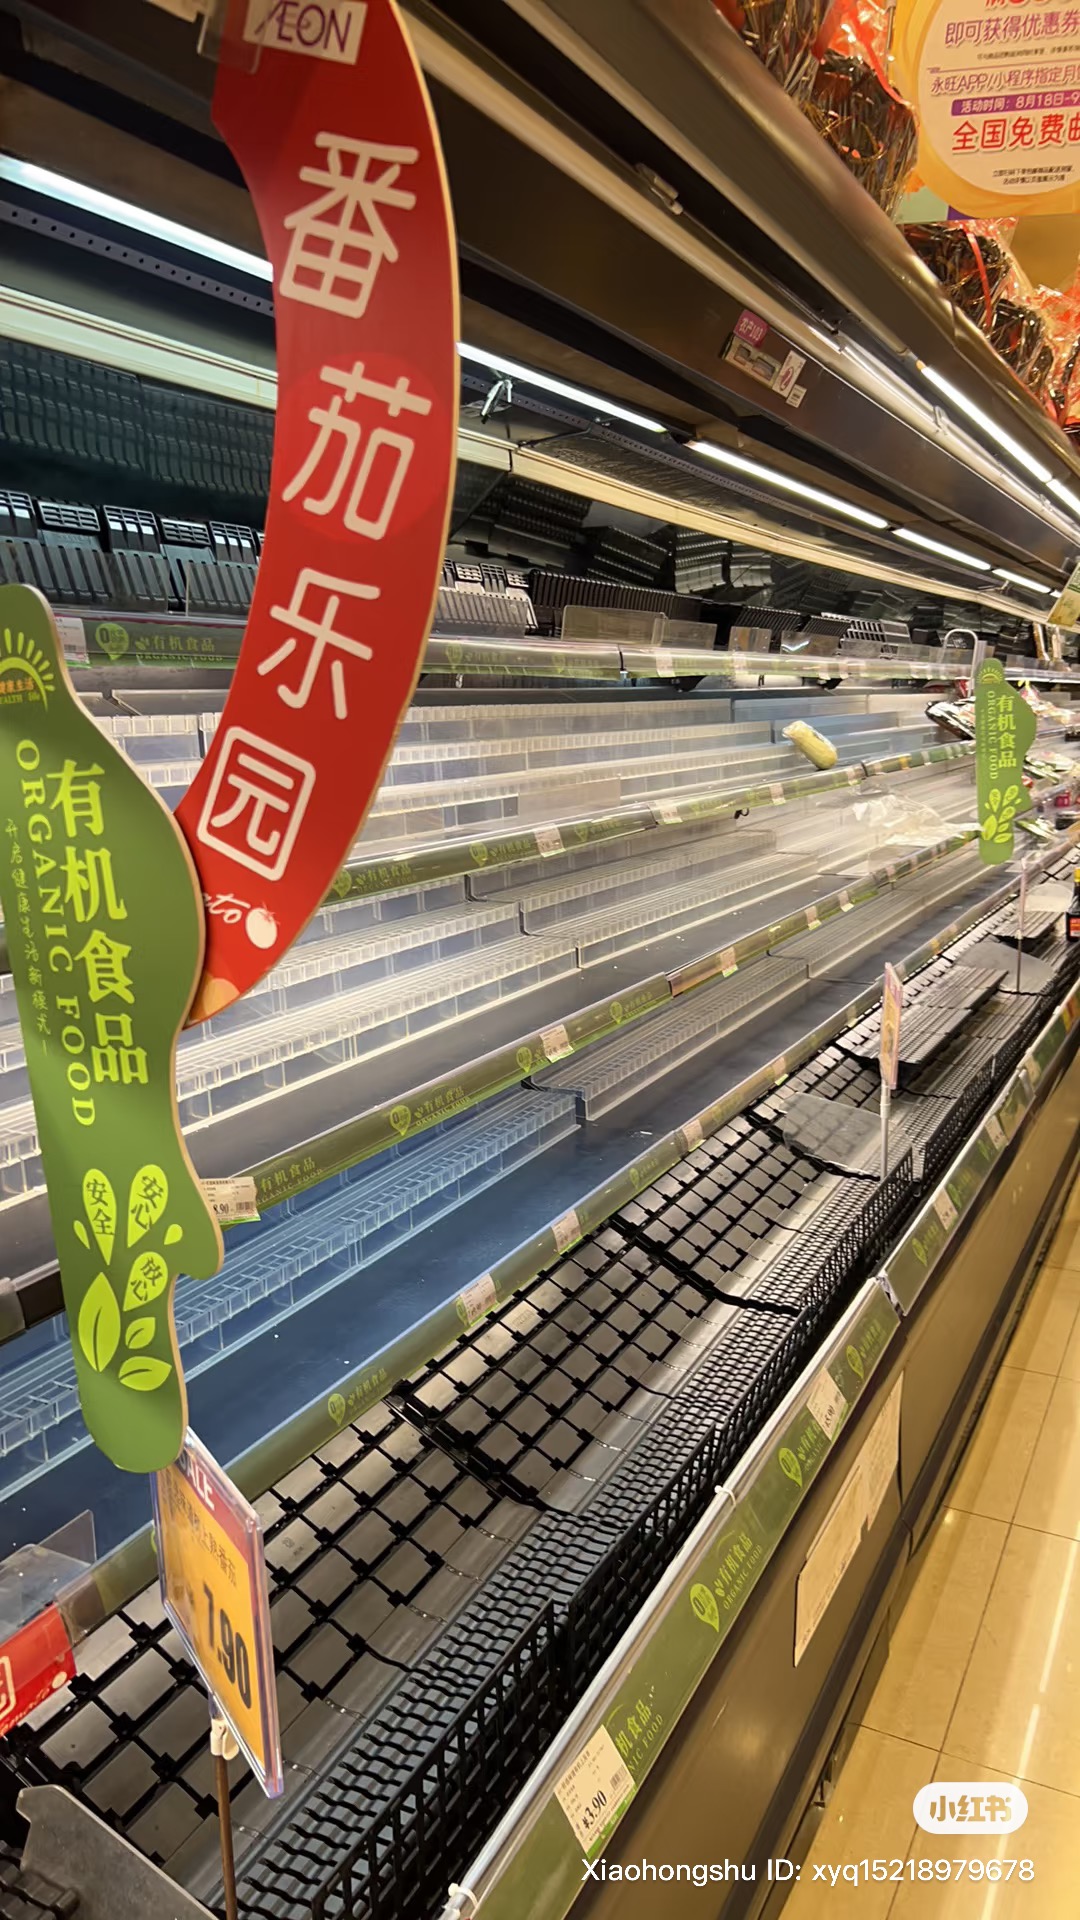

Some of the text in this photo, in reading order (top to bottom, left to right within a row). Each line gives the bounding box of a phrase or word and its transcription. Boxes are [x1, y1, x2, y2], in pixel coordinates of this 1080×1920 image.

[931, 66, 1080, 93] 永旺APP/小程序指定月
[197, 131, 432, 881] 番茄乐园
[987, 690, 998, 744] ORGANIC
[997, 694, 1017, 769] 有机食品
[988, 748, 999, 780] FOOD
[15, 738, 96, 1127] ORGANIC FOOD
[46, 758, 149, 1084] 有机食品
[261, 1156, 316, 1193] 有机食品
[86, 1179, 115, 1236] 安全
[130, 1176, 164, 1231] 安心
[130, 1256, 163, 1302] 放心
[719, 1531, 753, 1585] 有机食品
[203, 1581, 252, 1710] 7.90
[641, 1714, 664, 1749] FOOD
[582, 1789, 608, 1830] ¥3.90
